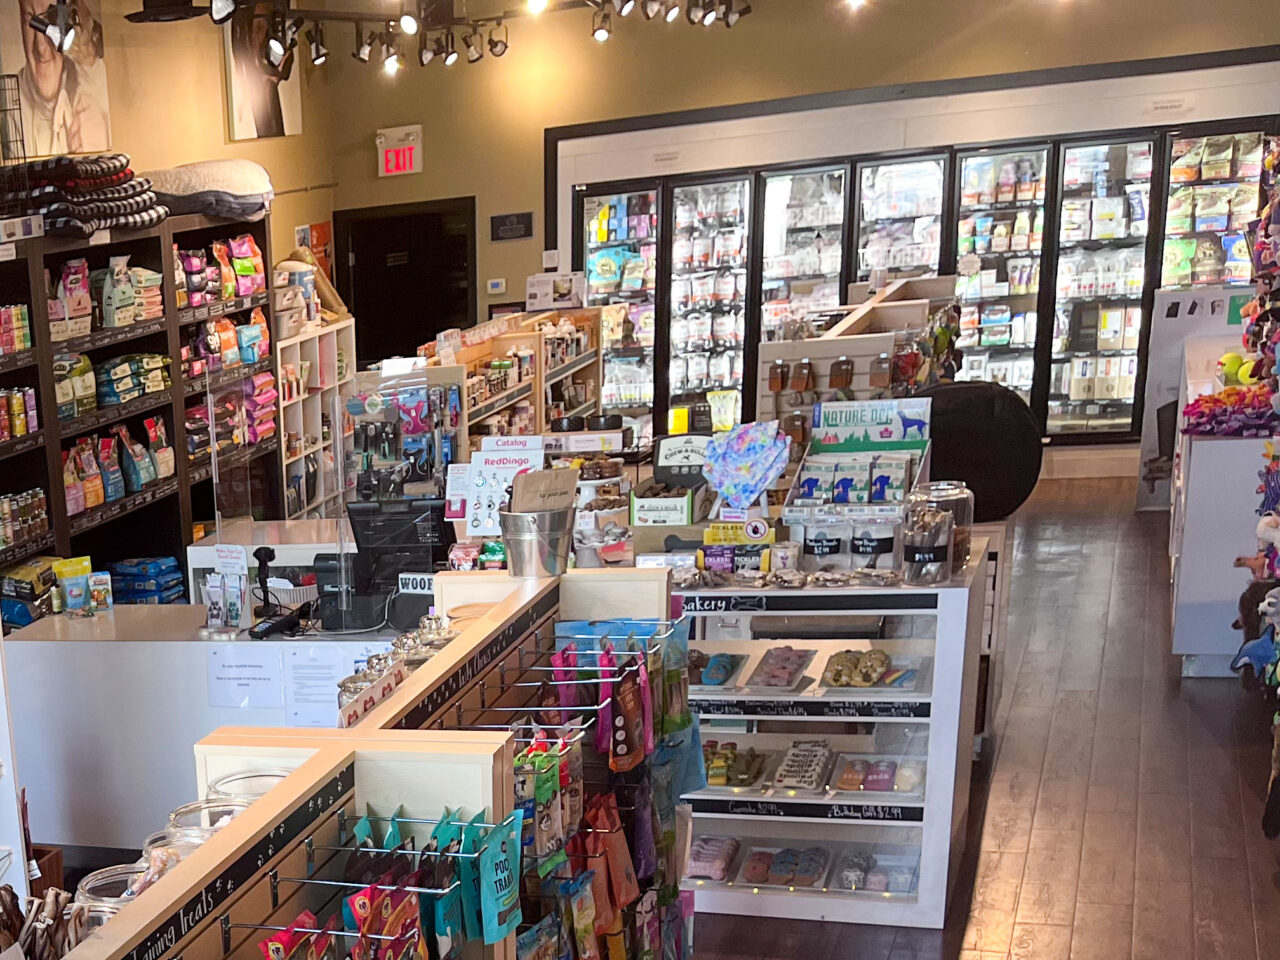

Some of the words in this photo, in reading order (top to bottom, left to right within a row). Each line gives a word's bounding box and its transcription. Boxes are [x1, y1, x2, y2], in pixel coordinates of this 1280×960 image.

[384, 147, 415, 173] EXIT
[823, 406, 868, 427] NATURE
[496, 438, 527, 448] Catalog
[484, 457, 530, 467] RedDingo
[712, 524, 742, 532] TICKLESS
[176, 890, 214, 934] Treats
